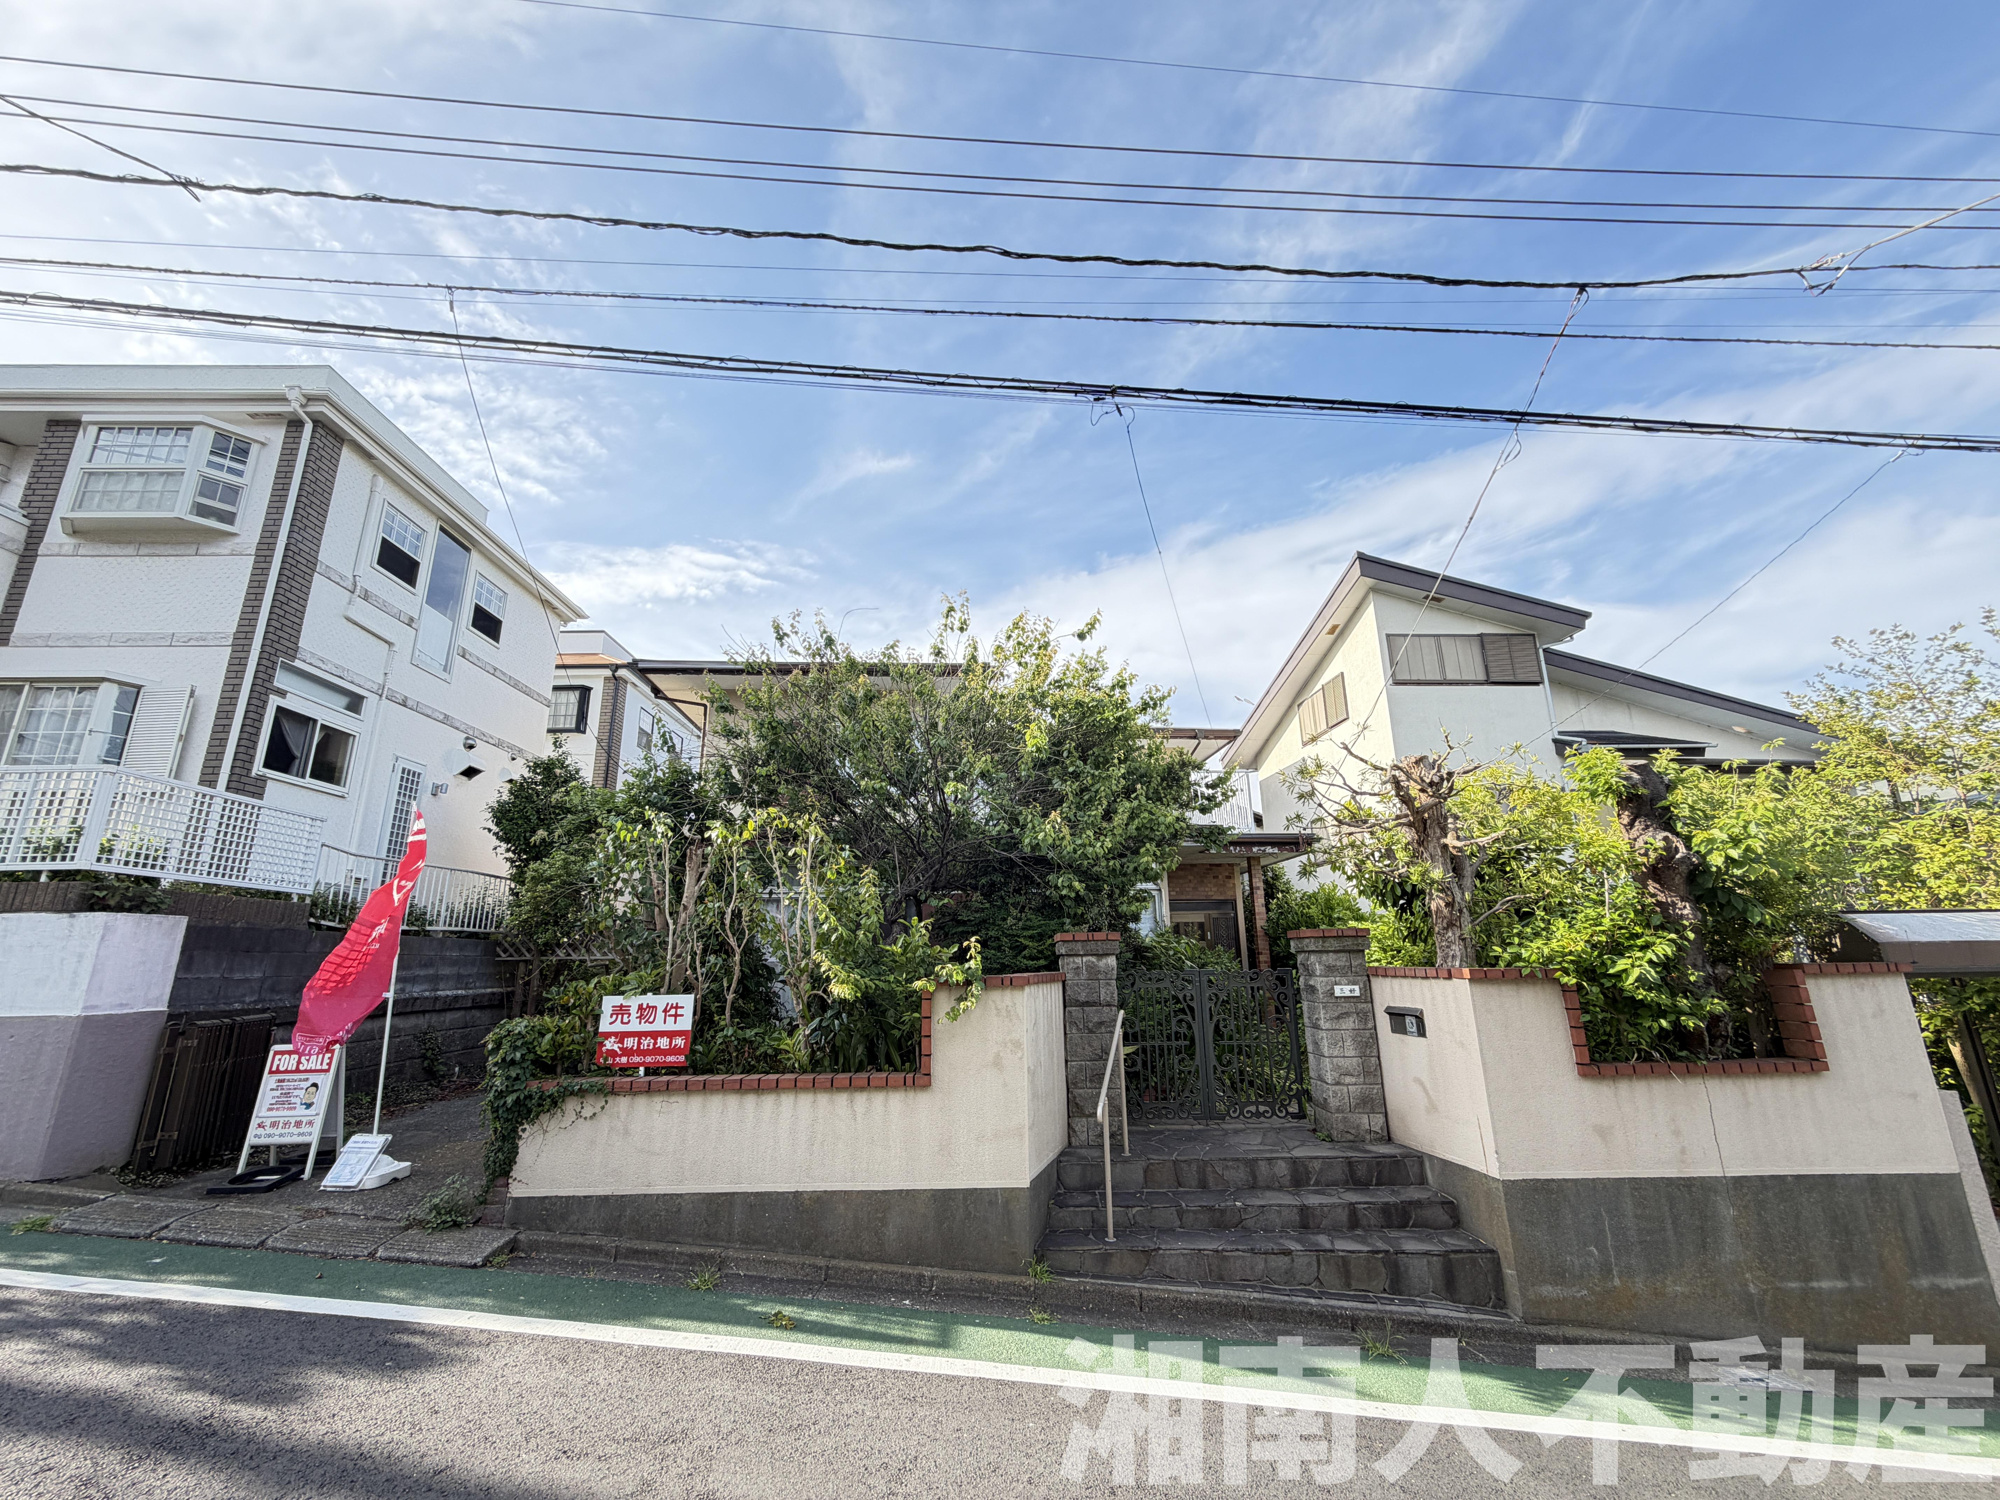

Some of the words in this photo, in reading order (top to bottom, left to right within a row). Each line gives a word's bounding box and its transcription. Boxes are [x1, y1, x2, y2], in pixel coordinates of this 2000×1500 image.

[609, 1002, 685, 1025] 売物件
[623, 1036, 686, 1050] 明治地所
[272, 1054, 298, 1071] FOR
[299, 1053, 332, 1071] SALE
[629, 1055, 685, 1063] 090-9070-9609
[269, 1119, 315, 1130] 明治地所
